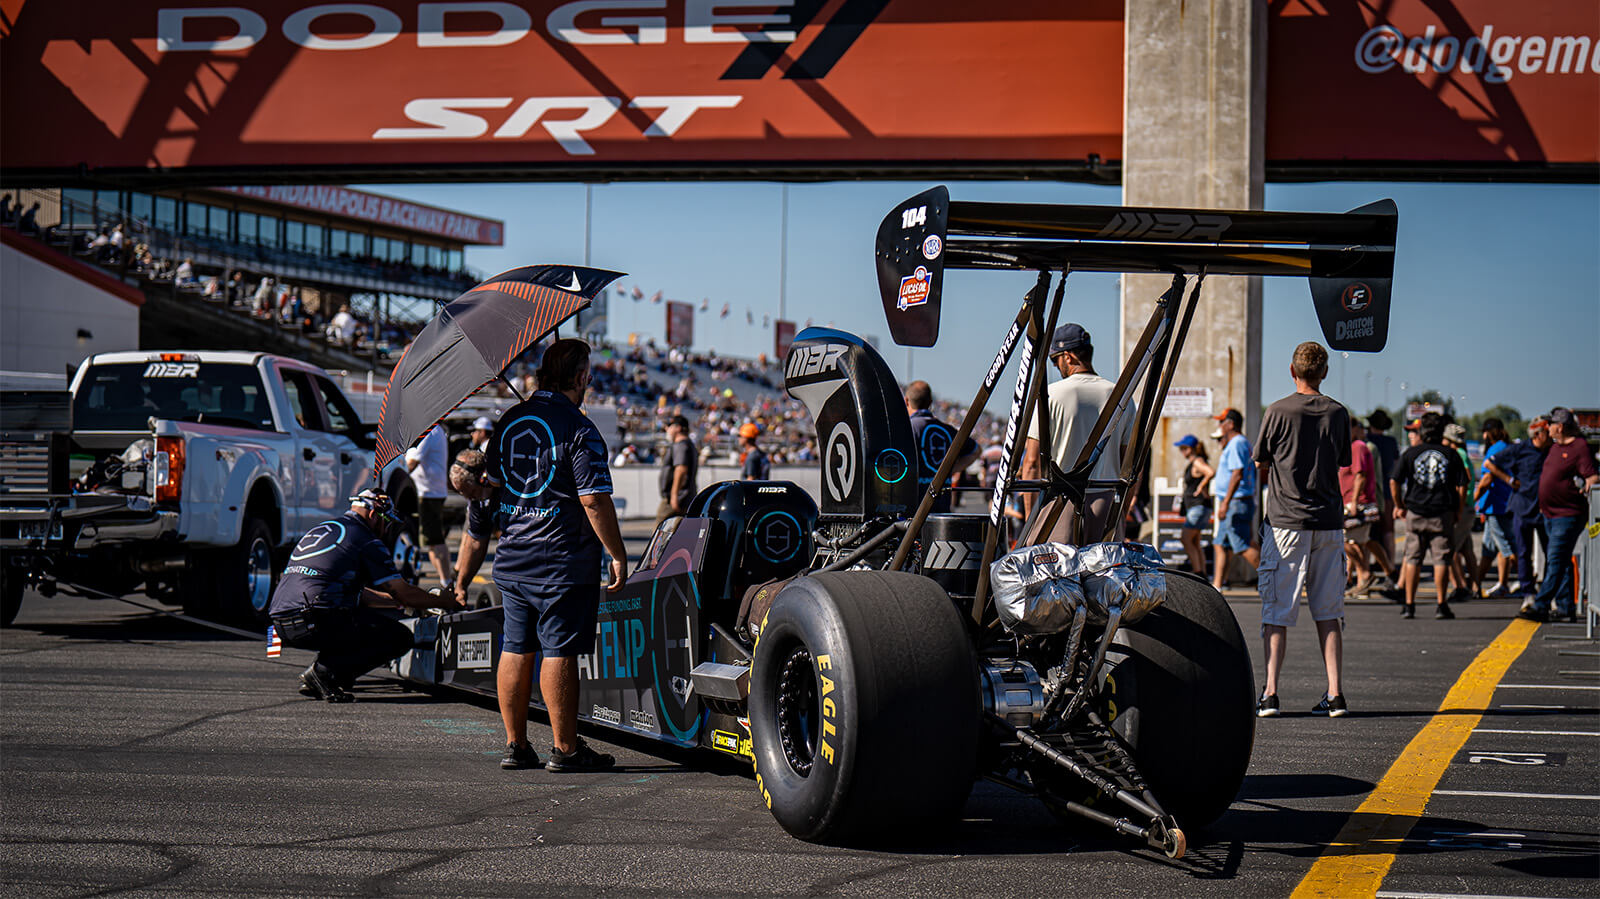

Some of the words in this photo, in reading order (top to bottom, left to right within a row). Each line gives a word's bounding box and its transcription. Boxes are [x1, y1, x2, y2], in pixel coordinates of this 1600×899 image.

[157, 0, 797, 51] DODGE
[373, 95, 743, 155] SRT
[380, 200, 447, 231] RACEWAY
[446, 214, 480, 241] PARK
[902, 205, 927, 229] 104
[985, 323, 1019, 387] GOODYEAR
[817, 654, 836, 765] EAGLE
